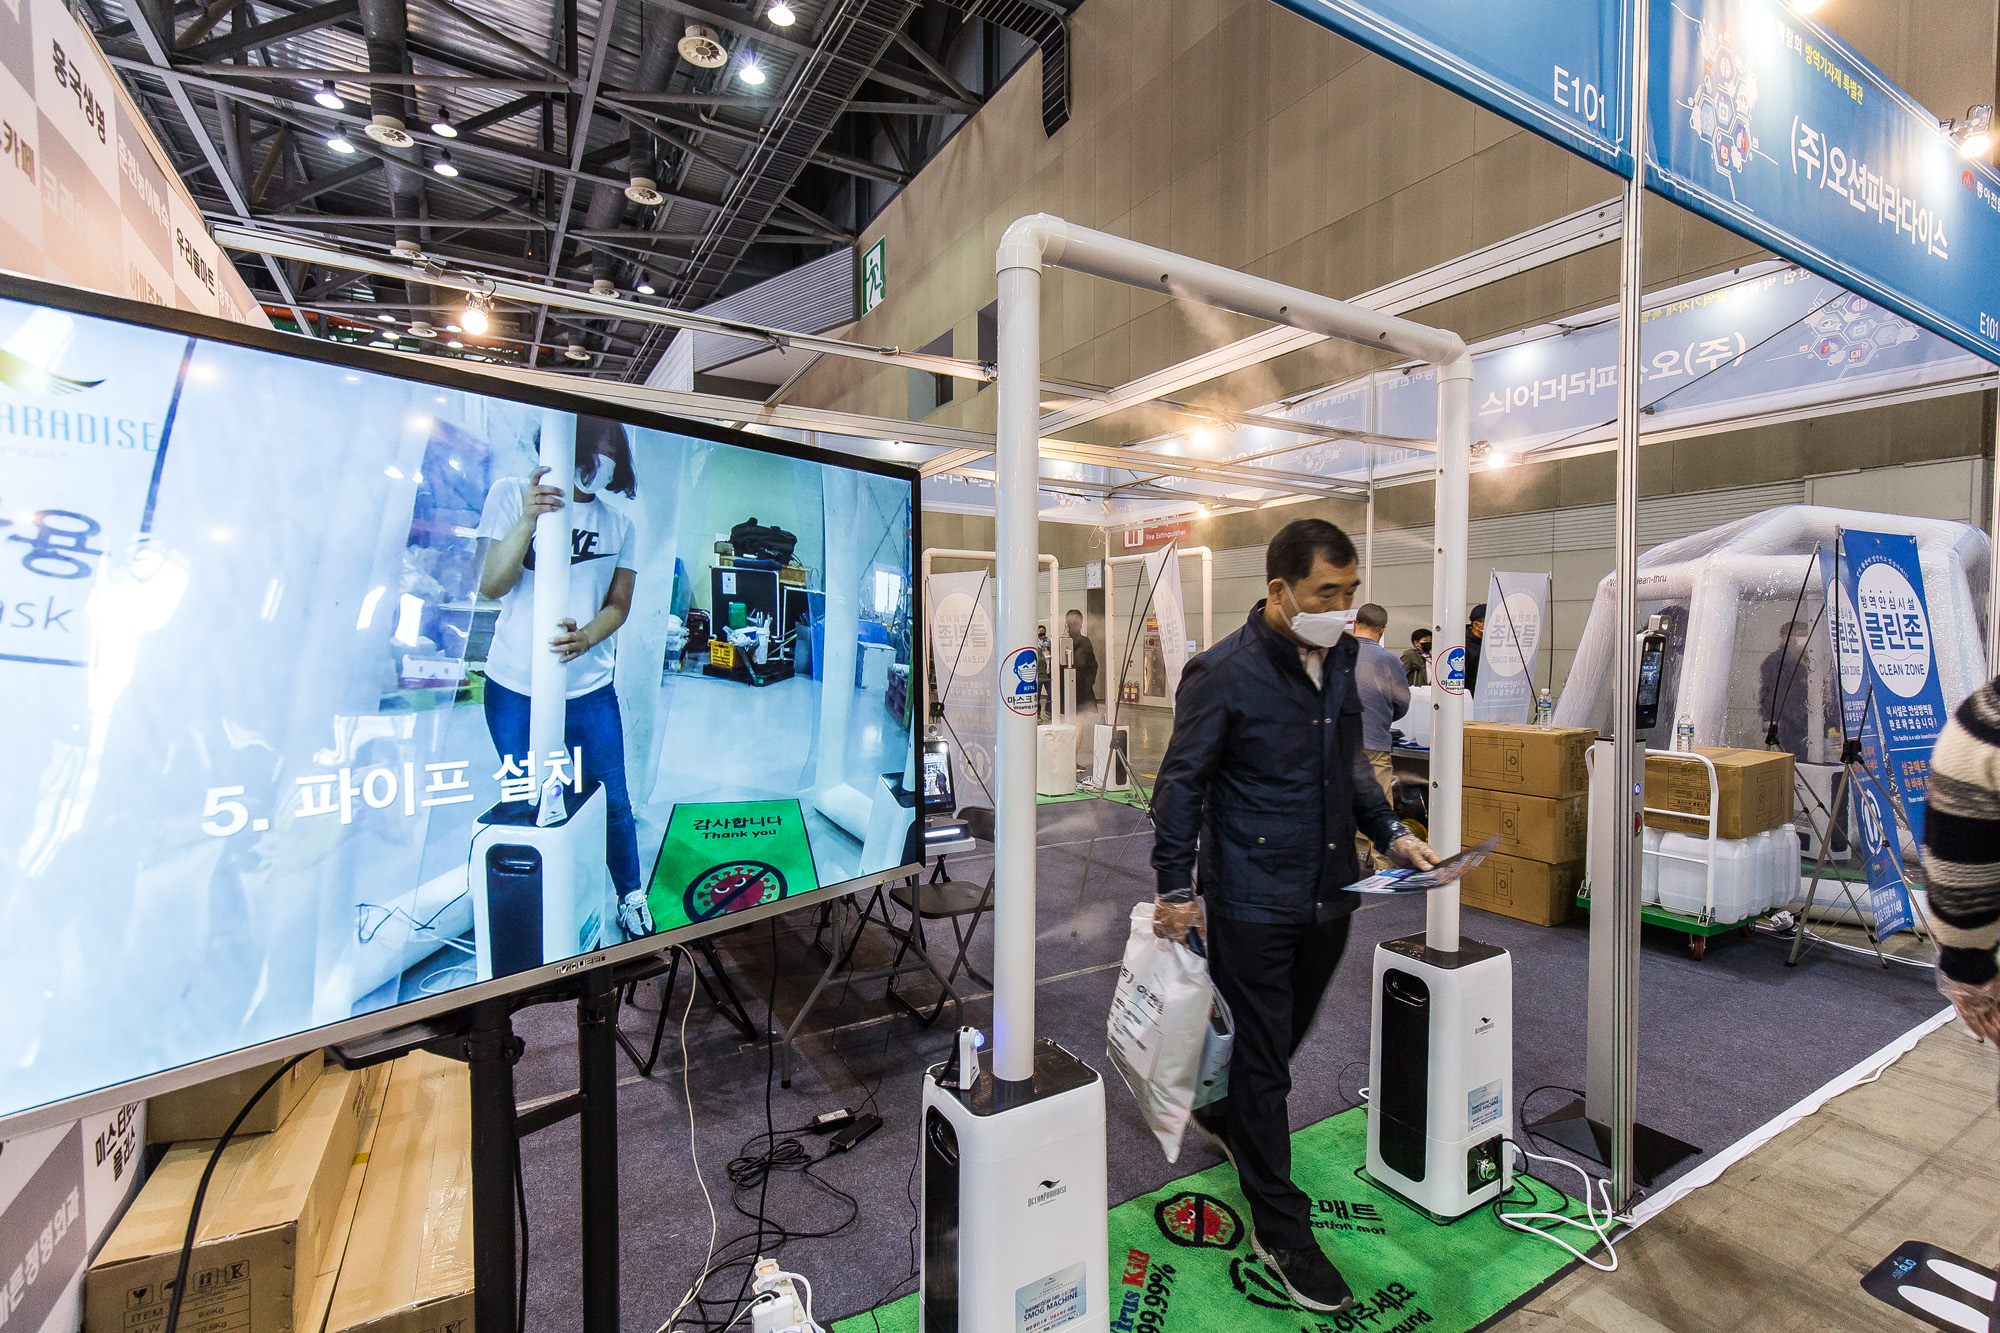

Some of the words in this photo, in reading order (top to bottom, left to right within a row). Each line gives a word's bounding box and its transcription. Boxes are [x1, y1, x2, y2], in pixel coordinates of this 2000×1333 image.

[1804, 42, 1841, 89] 방역기자재
[1842, 74, 1864, 105] 특별관
[1553, 65, 1606, 128] E101
[0, 118, 35, 186] 카페
[1791, 114, 1949, 260] (주)오션파라다이스
[1976, 181, 2000, 214] 동아전
[176, 227, 215, 297] 우리들마트
[1980, 311, 1999, 342] E101
[571, 528, 600, 555] KE
[0, 594, 73, 632] sk
[1860, 594, 1915, 612] 방역안심시설
[1864, 612, 1925, 651] 클린존
[1878, 664, 1903, 676] CLEAN
[1904, 663, 1926, 676] ZONE
[1007, 695, 1033, 705] 마스크
[1886, 706, 1892, 717] 이
[1892, 705, 1908, 717] 시설은
[1908, 704, 1934, 716] 안심방역을
[1889, 718, 1938, 730] 완료하였습니다!
[201, 785, 269, 838] 5.
[295, 760, 475, 826] 파이프
[492, 746, 583, 806] 설치
[692, 814, 783, 831] 감사합니다
[701, 829, 748, 841] Thank
[751, 828, 777, 840] you
[1310, 1199, 1384, 1221] 매트
[1356, 1225, 1386, 1235] mat
[1122, 1248, 1151, 1288] Kill
[132, 1308, 163, 1323] ITEM
[1023, 1306, 1045, 1322] SMOG
[1046, 1290, 1079, 1312] MACHINE
